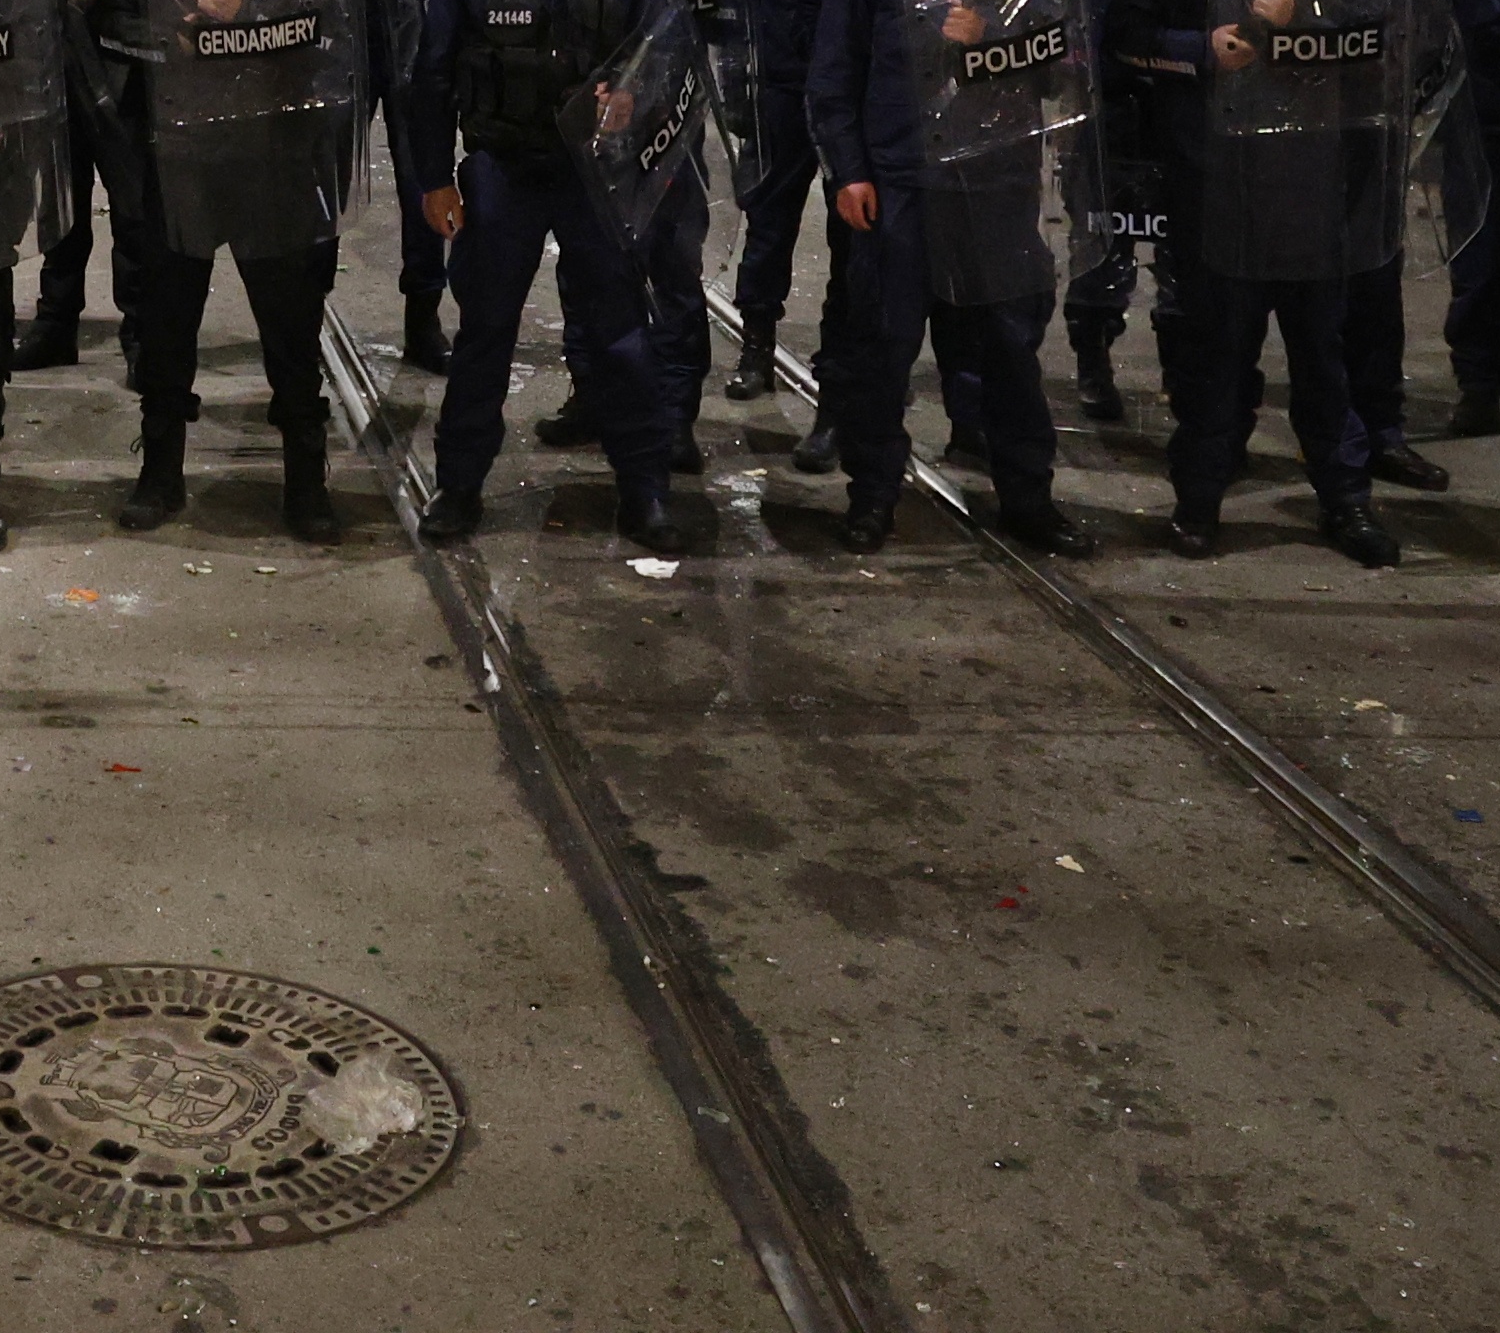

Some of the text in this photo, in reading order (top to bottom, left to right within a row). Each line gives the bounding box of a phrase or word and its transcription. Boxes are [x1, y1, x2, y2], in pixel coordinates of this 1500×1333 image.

[199, 17, 317, 54] GENDARMERY
[487, 10, 532, 24] 241445
[965, 28, 1065, 77] POLICE
[1272, 30, 1379, 60] POLICE
[640, 69, 696, 169] POLICE
